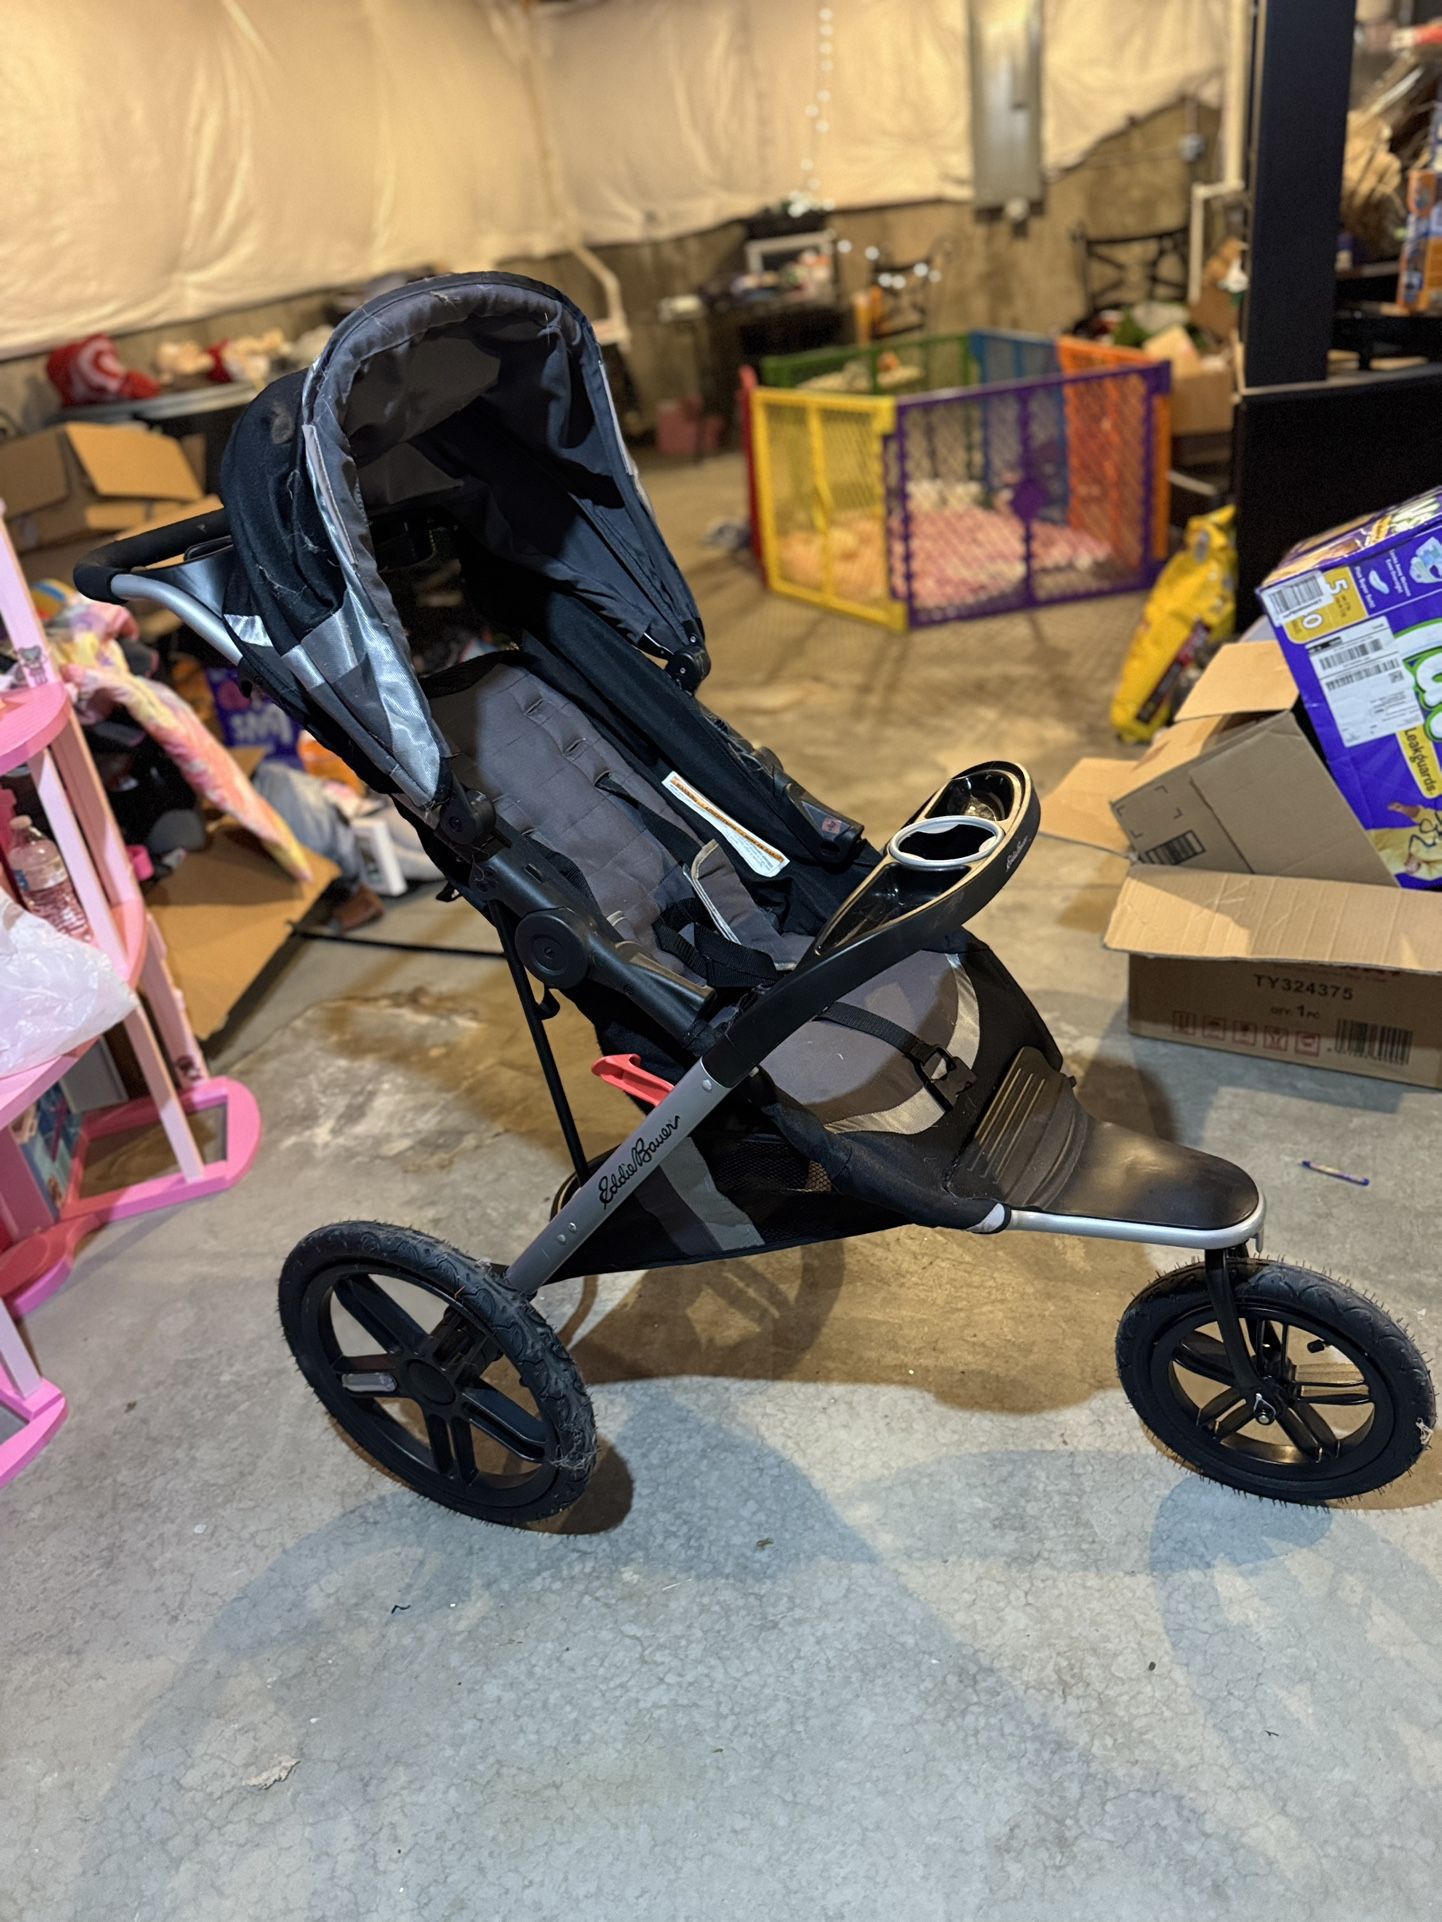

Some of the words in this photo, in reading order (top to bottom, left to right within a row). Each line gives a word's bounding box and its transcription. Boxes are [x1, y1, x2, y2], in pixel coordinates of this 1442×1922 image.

[1253, 973, 1353, 1000] TY324375
[598, 1163, 638, 1210] Eddie
[632, 1115, 680, 1167] Bauer
